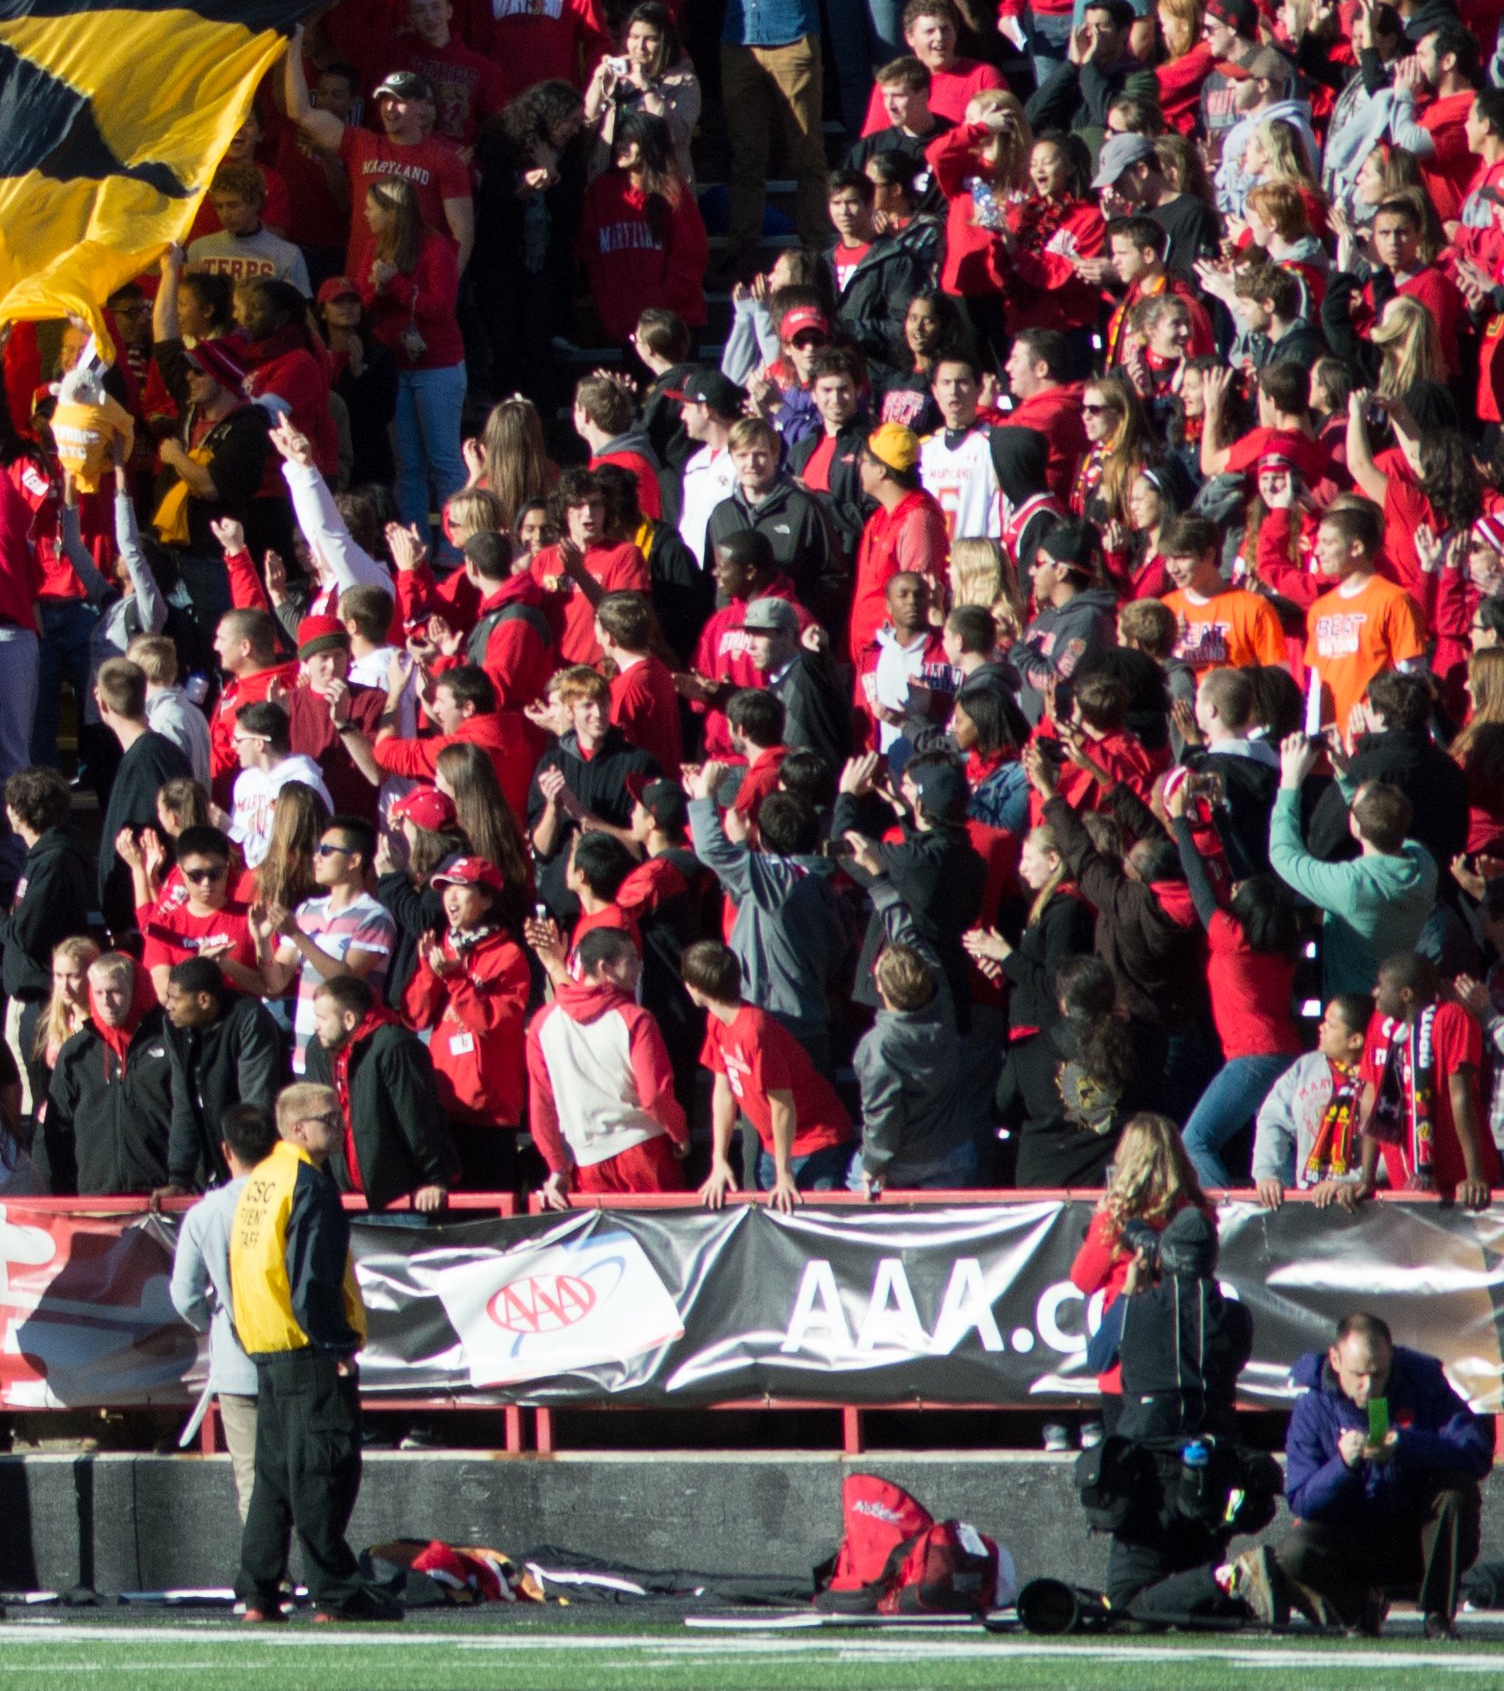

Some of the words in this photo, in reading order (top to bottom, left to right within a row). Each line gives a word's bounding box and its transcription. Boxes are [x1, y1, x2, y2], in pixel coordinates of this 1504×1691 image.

[361, 161, 430, 188] MARYLAND
[202, 258, 276, 282] TERPS
[1316, 614, 1367, 640] BEAT
[244, 1180, 277, 1205] CSC
[491, 1276, 595, 1332] AAA
